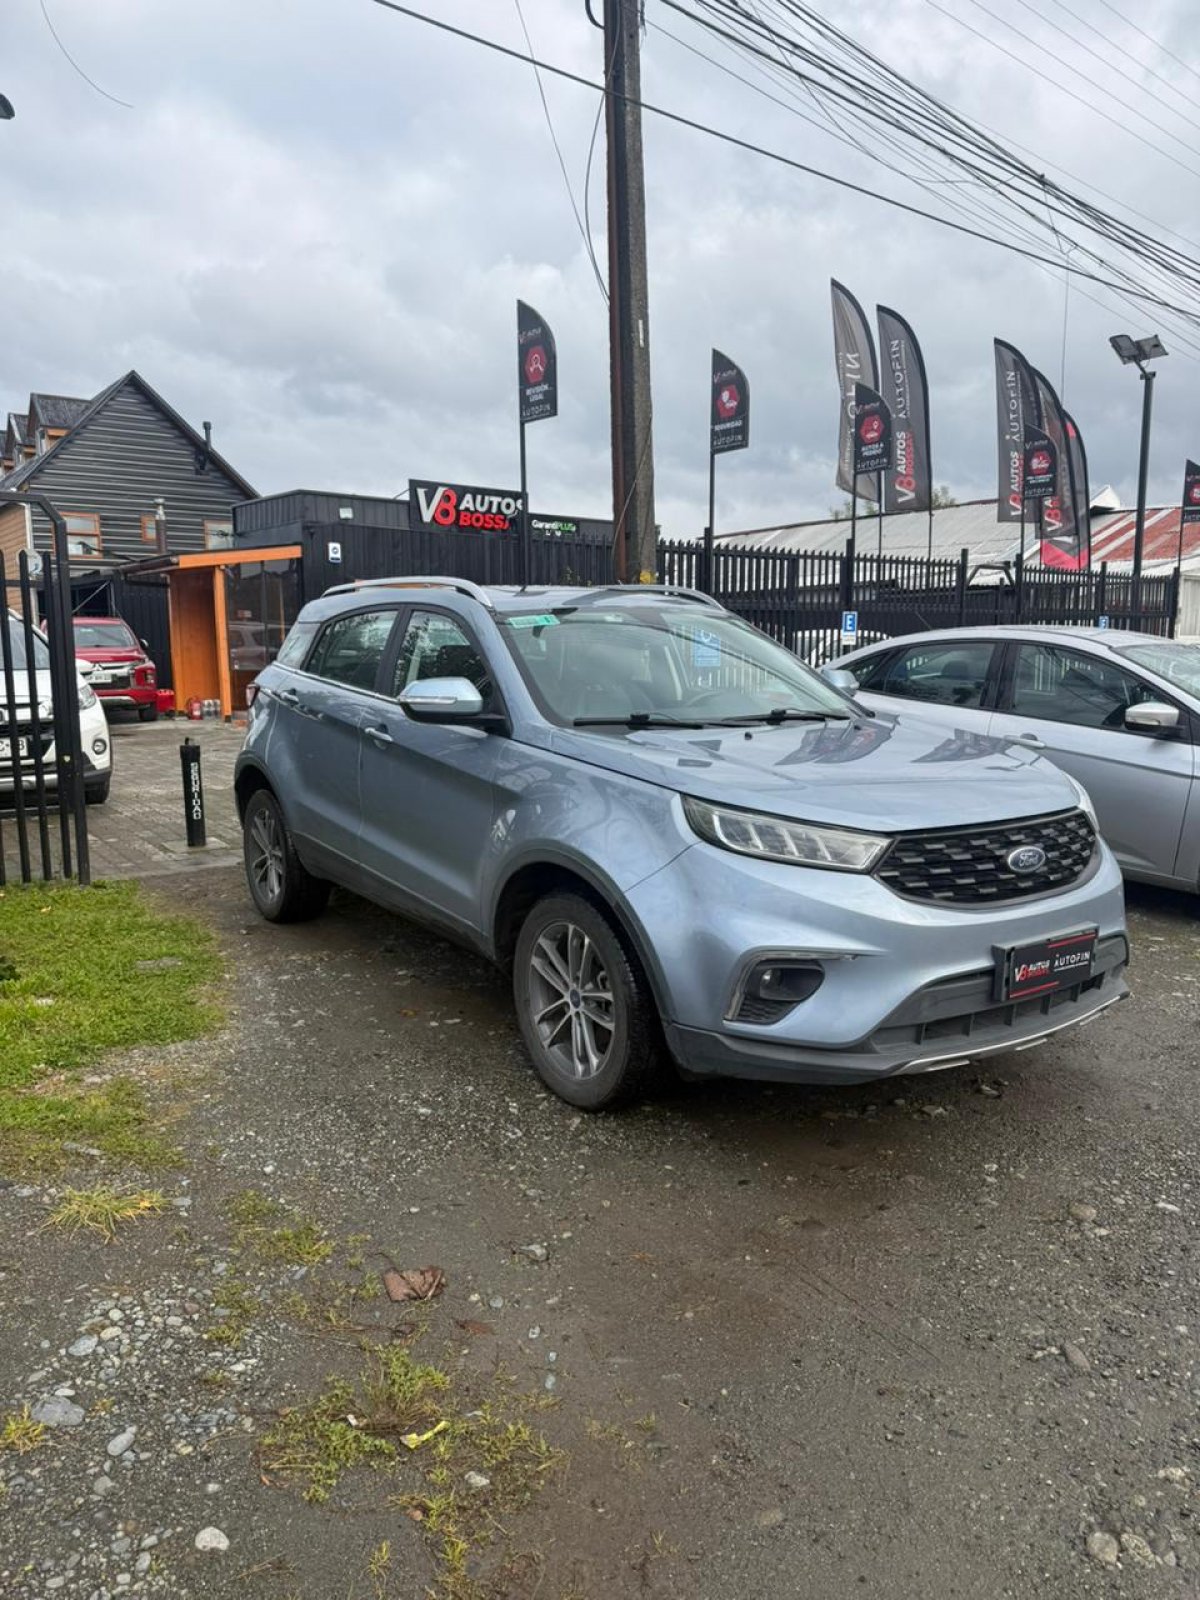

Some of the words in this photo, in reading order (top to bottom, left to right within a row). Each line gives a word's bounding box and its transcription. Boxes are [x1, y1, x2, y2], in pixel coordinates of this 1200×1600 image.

[1005, 371, 1021, 442] AUTOFIN
[895, 431, 906, 474] AUTOS
[1009, 450, 1020, 493] AUTOS
[416, 487, 457, 526] V8
[846, 614, 854, 630] E
[1018, 851, 1040, 867] Ford
[1054, 952, 1091, 968] AUTOFIN
